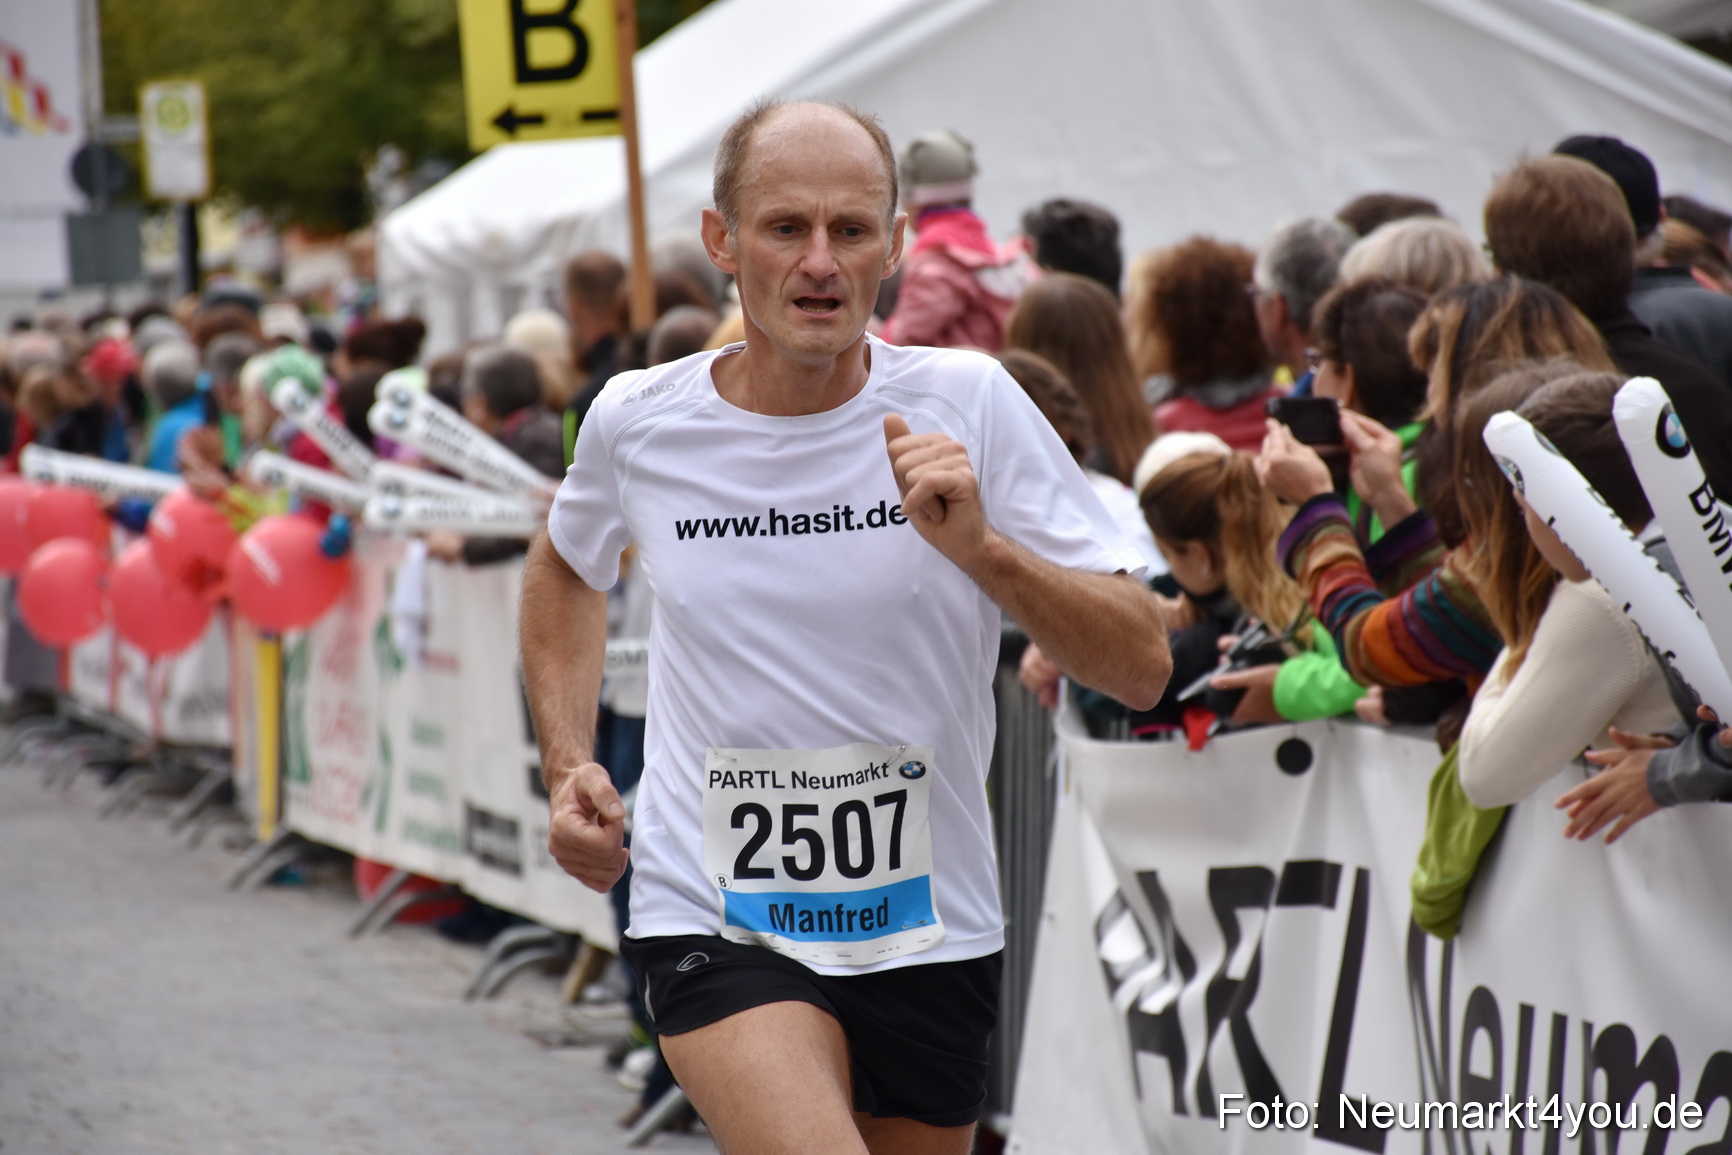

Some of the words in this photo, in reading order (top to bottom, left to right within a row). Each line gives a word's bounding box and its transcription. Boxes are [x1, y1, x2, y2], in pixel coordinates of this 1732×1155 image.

[509, 0, 590, 84] B
[640, 383, 676, 400] JAKO
[675, 500, 909, 541] www.hasit.de
[709, 770, 786, 789] PARTL
[791, 762, 890, 790] Neumarkt
[730, 788, 908, 882] 2507
[718, 876, 728, 888] B
[768, 897, 889, 934] Manfred
